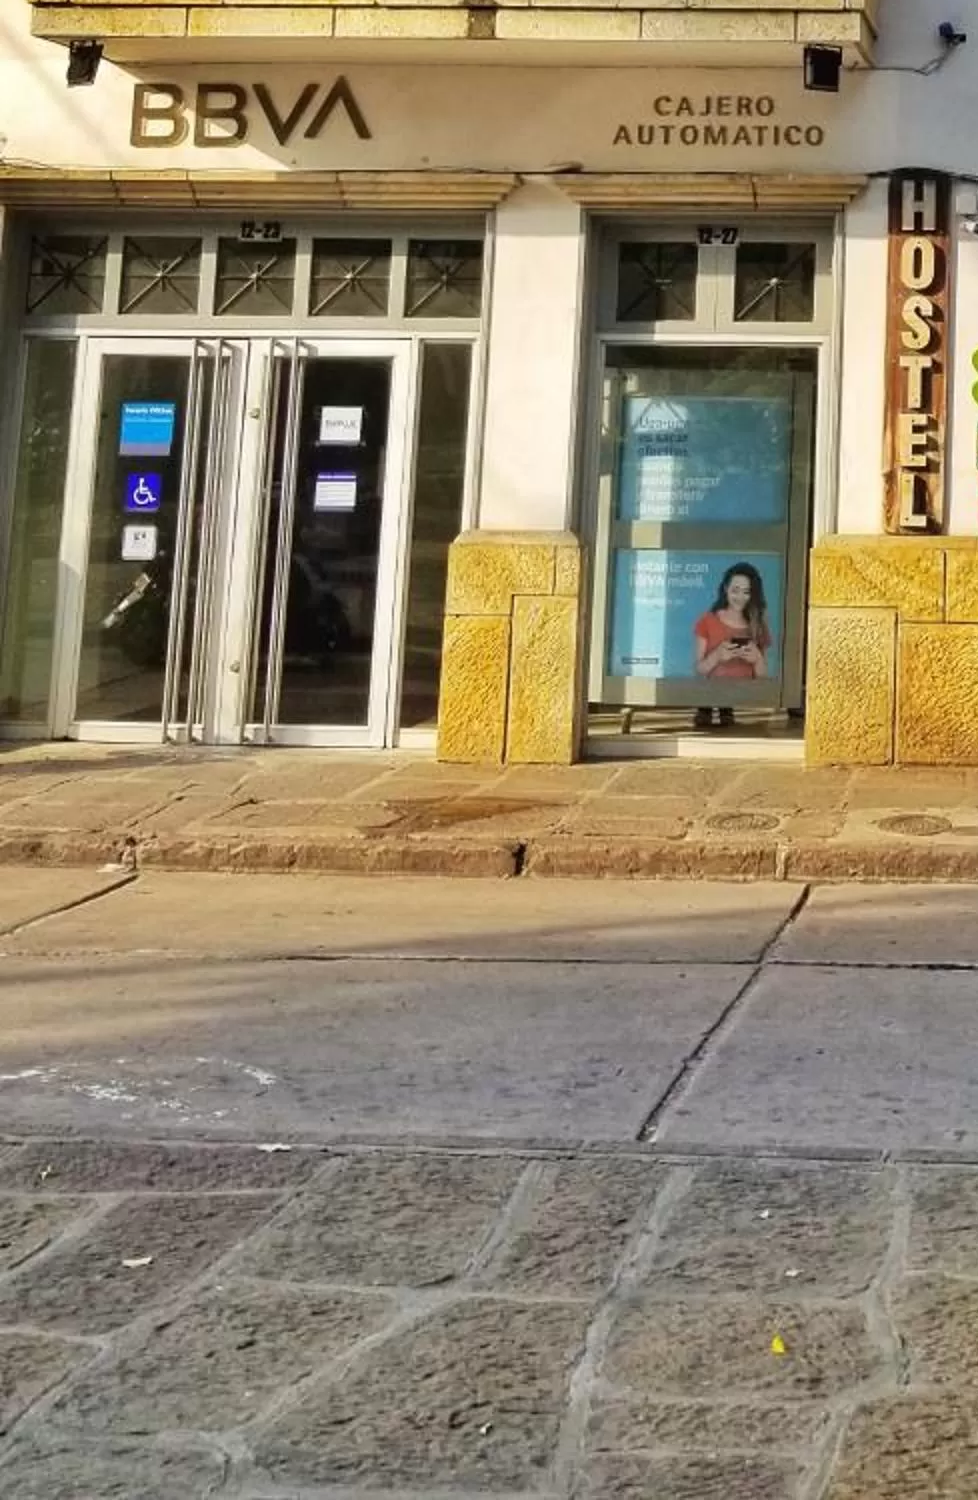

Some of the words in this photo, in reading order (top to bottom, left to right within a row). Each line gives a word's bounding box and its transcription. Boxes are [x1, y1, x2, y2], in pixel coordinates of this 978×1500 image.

[130, 74, 373, 149] BBVA
[653, 95, 775, 117] CAJERO
[612, 124, 825, 147] AUTOMATICO
[240, 220, 281, 239] 12-23
[697, 227, 739, 245] 12-27
[900, 179, 936, 528] HOSTEL
